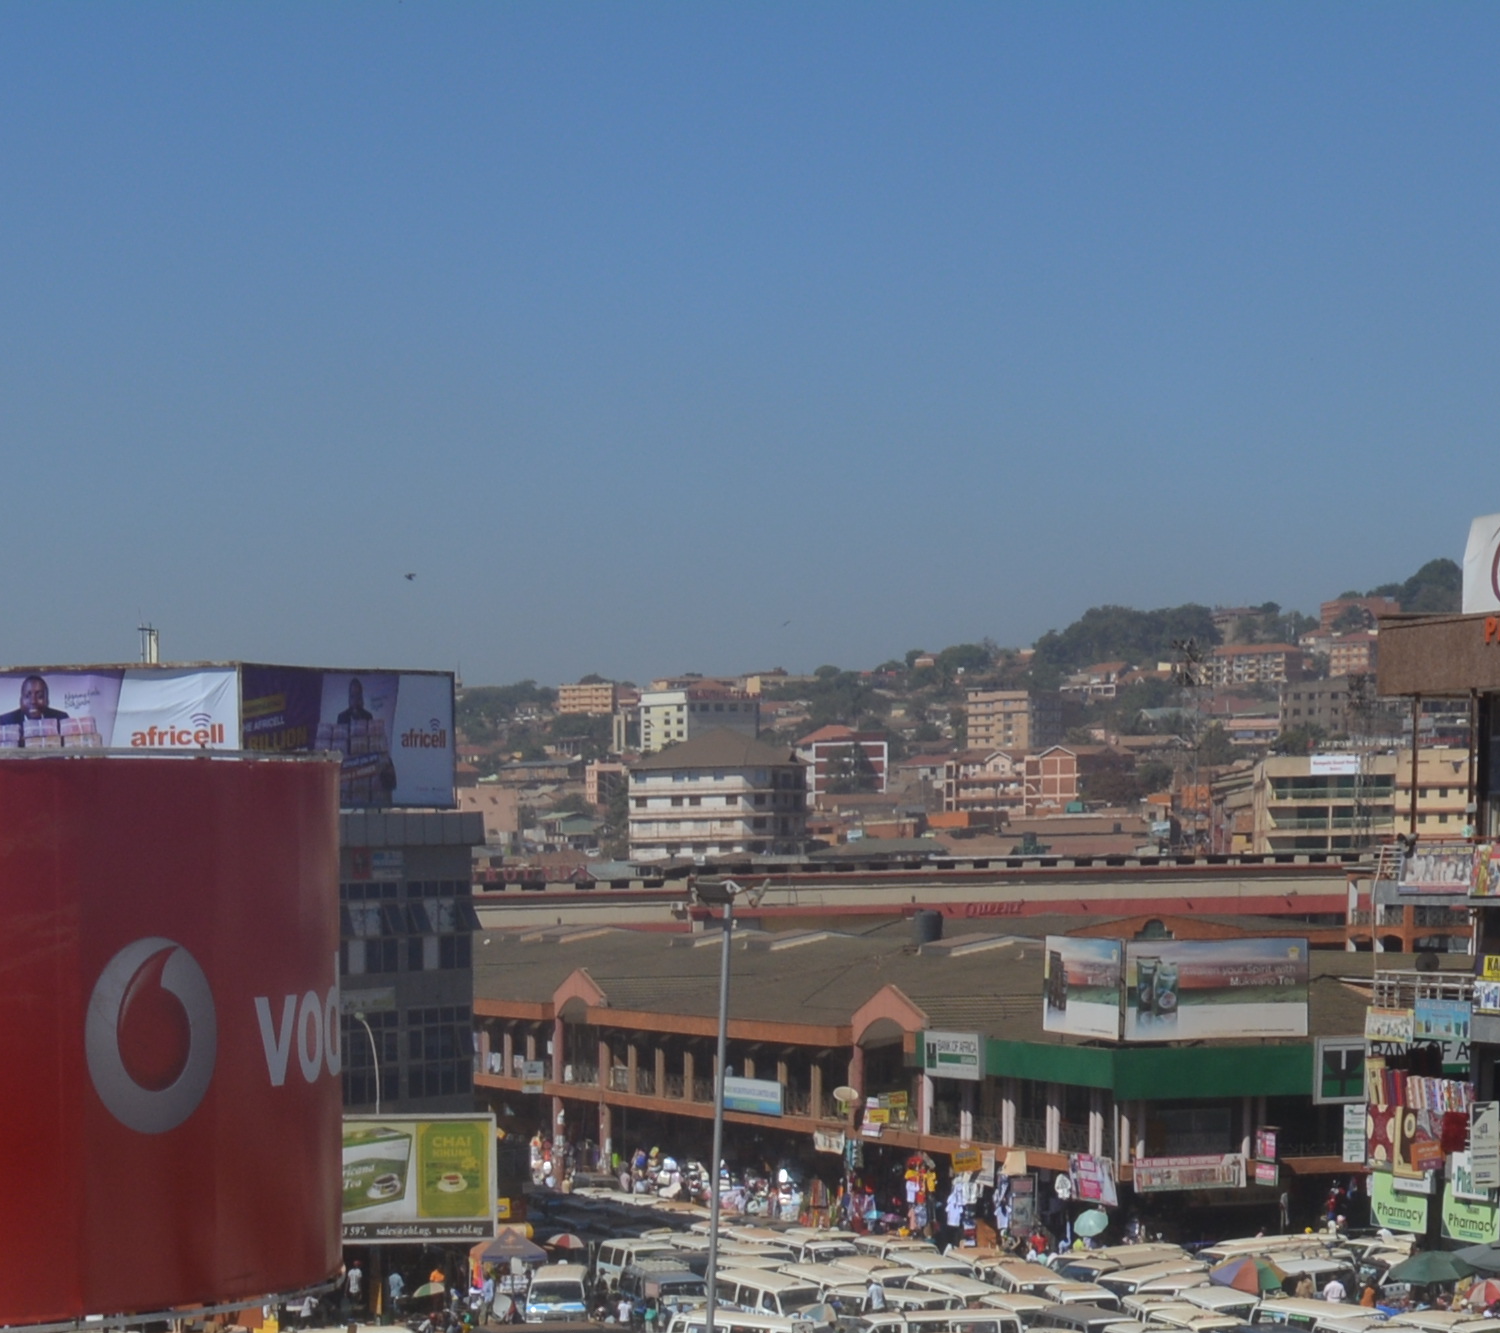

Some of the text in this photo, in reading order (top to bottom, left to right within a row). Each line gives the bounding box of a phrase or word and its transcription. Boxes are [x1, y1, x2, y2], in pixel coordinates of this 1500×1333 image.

[130, 722, 225, 747] africell
[431, 1135, 473, 1149] CHAI
[1375, 1204, 1424, 1224] Pharmacy
[1447, 1212, 1497, 1235] Pharmacy
